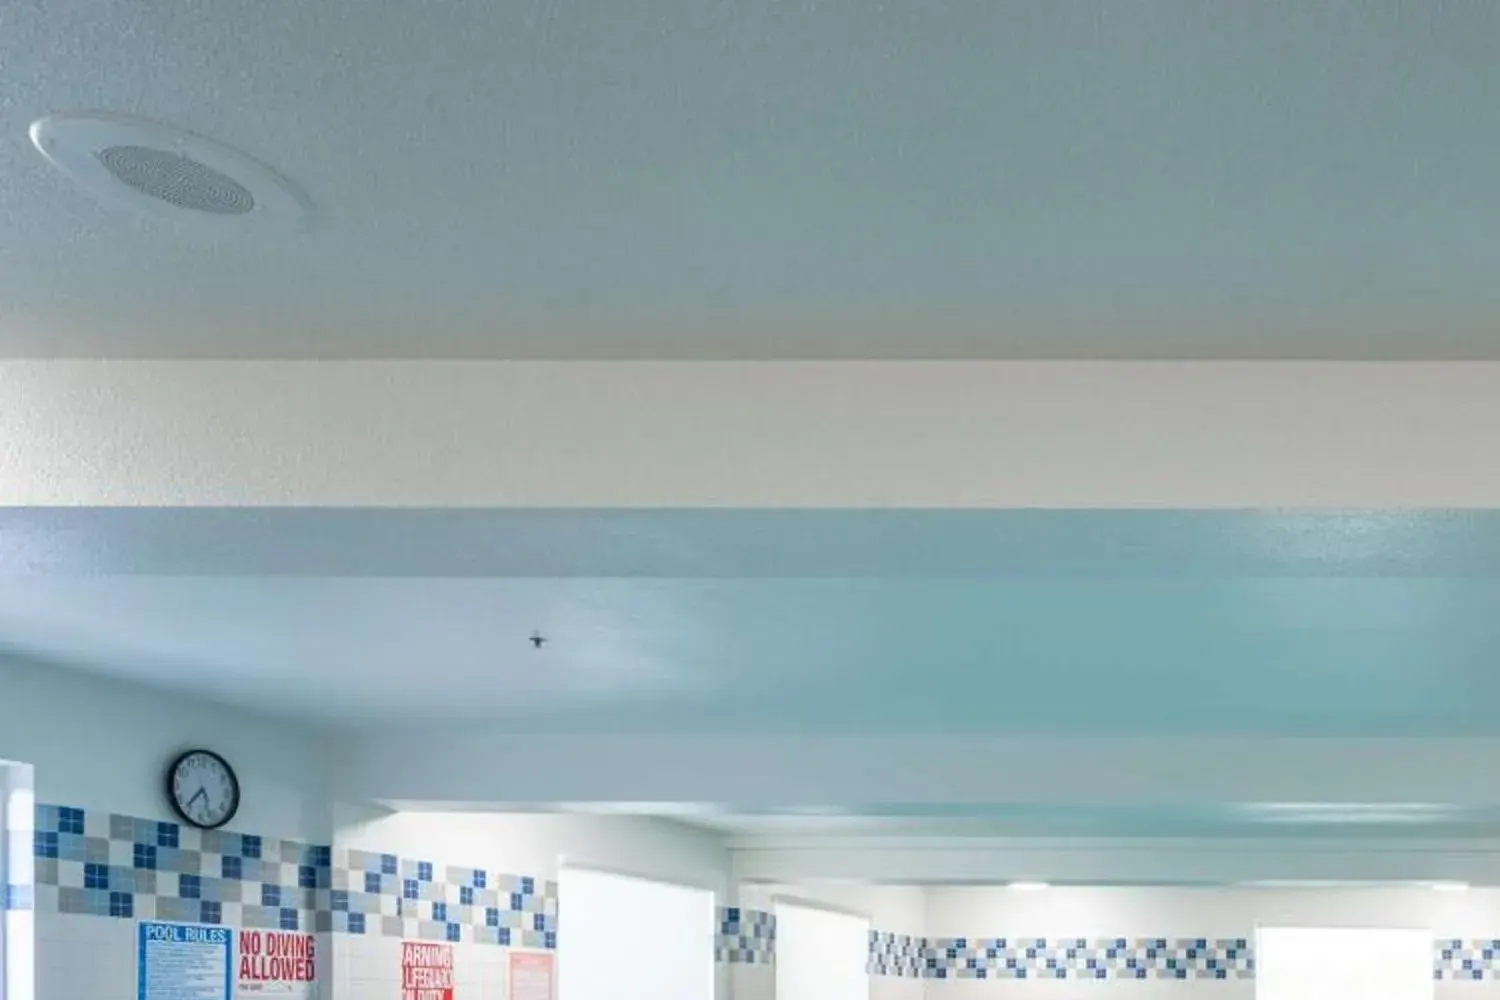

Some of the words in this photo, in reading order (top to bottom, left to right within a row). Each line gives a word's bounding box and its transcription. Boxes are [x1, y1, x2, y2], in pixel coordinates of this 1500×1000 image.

[146, 925, 181, 941] POOL
[185, 927, 226, 943] RULES
[239, 931, 261, 954] NO
[266, 933, 316, 958] DIVING
[401, 944, 450, 967] ARNING
[239, 957, 316, 981] ALLOWED
